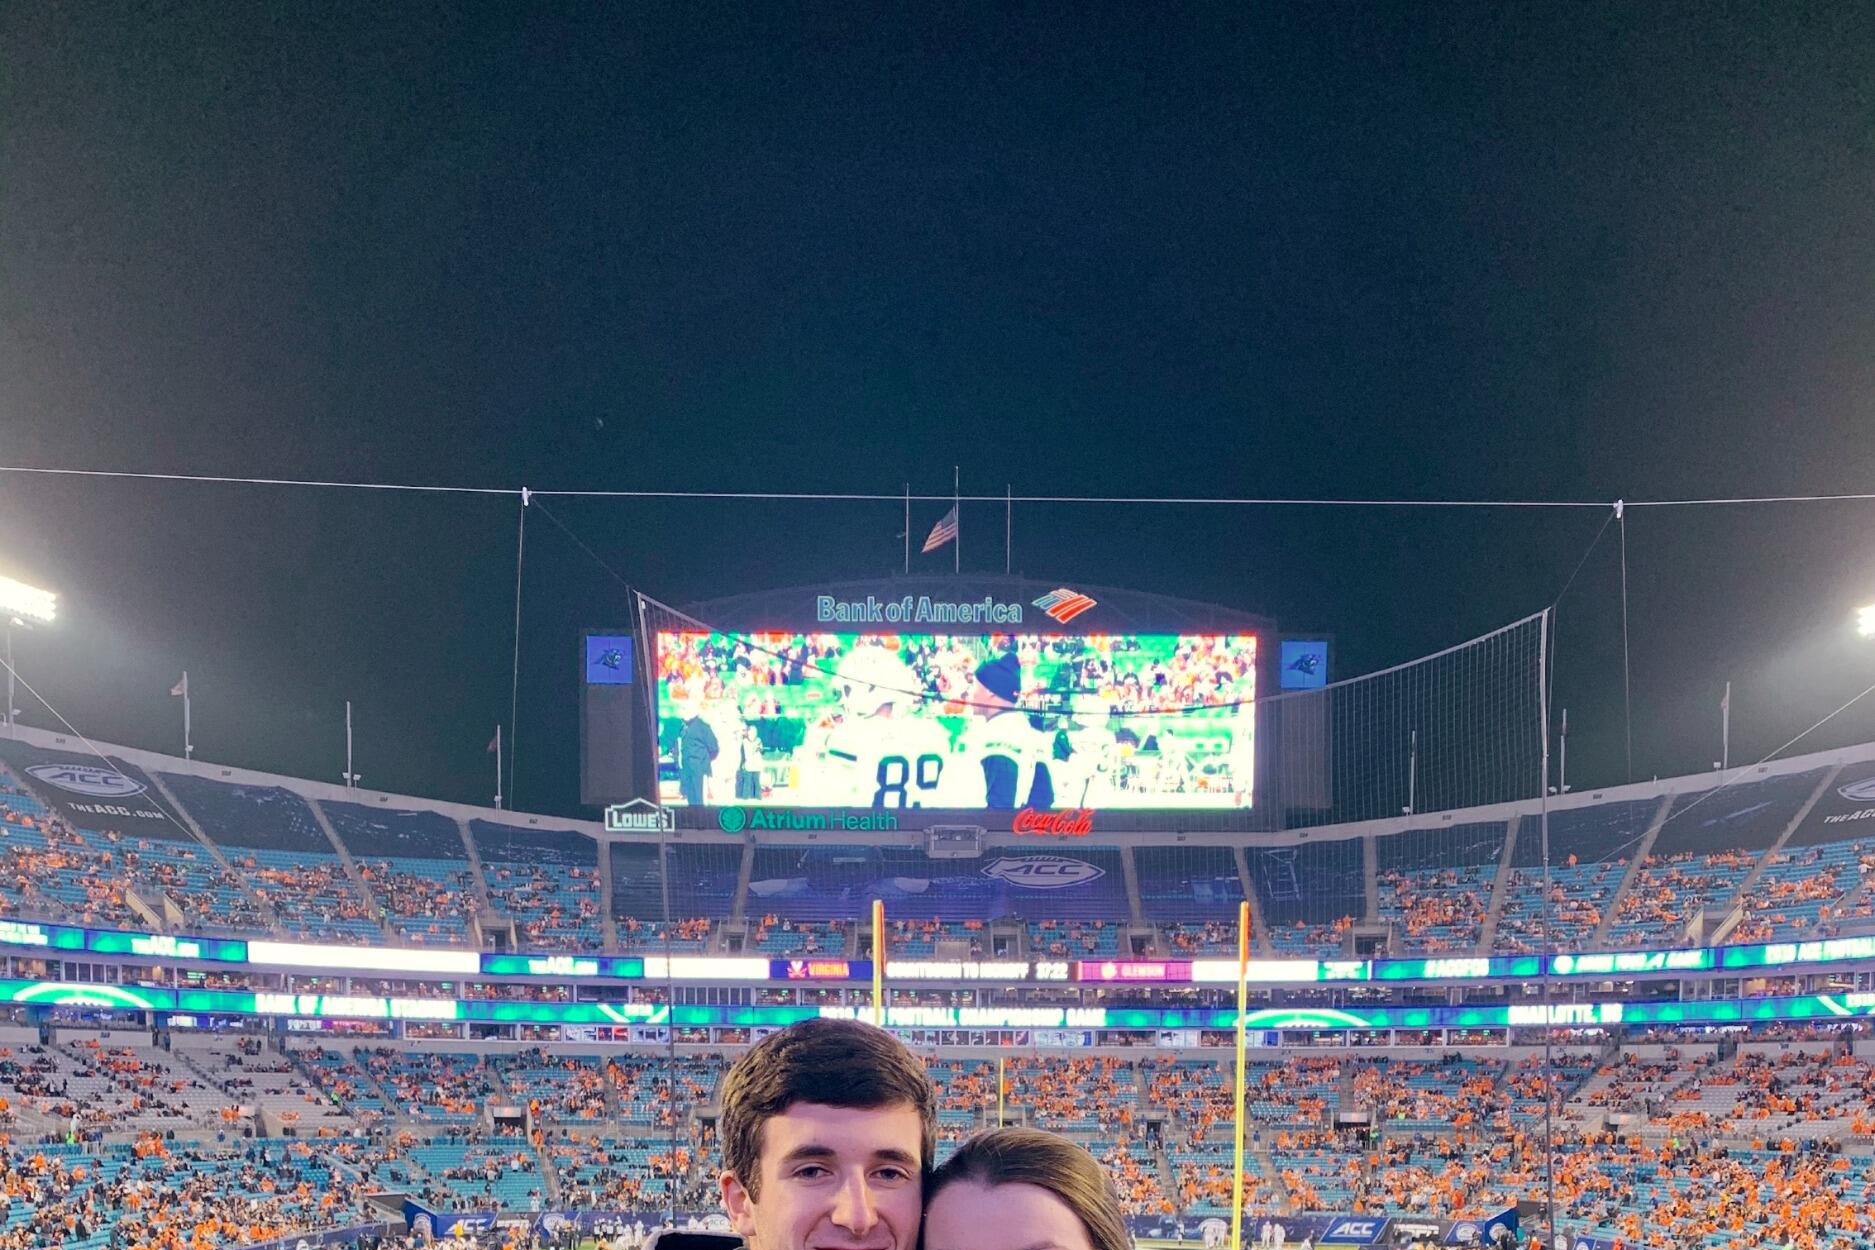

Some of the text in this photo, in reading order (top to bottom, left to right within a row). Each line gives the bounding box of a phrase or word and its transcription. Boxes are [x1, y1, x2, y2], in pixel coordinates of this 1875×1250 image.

[816, 596, 1023, 623] Bank of America
[51, 772, 125, 787] ACC
[750, 809, 898, 831] Atrium Health
[1824, 808, 1875, 824] THEAC
[1001, 864, 1081, 875] ACC
[1121, 963, 1166, 978] CLEMSON
[1332, 1222, 1376, 1236] ACC
